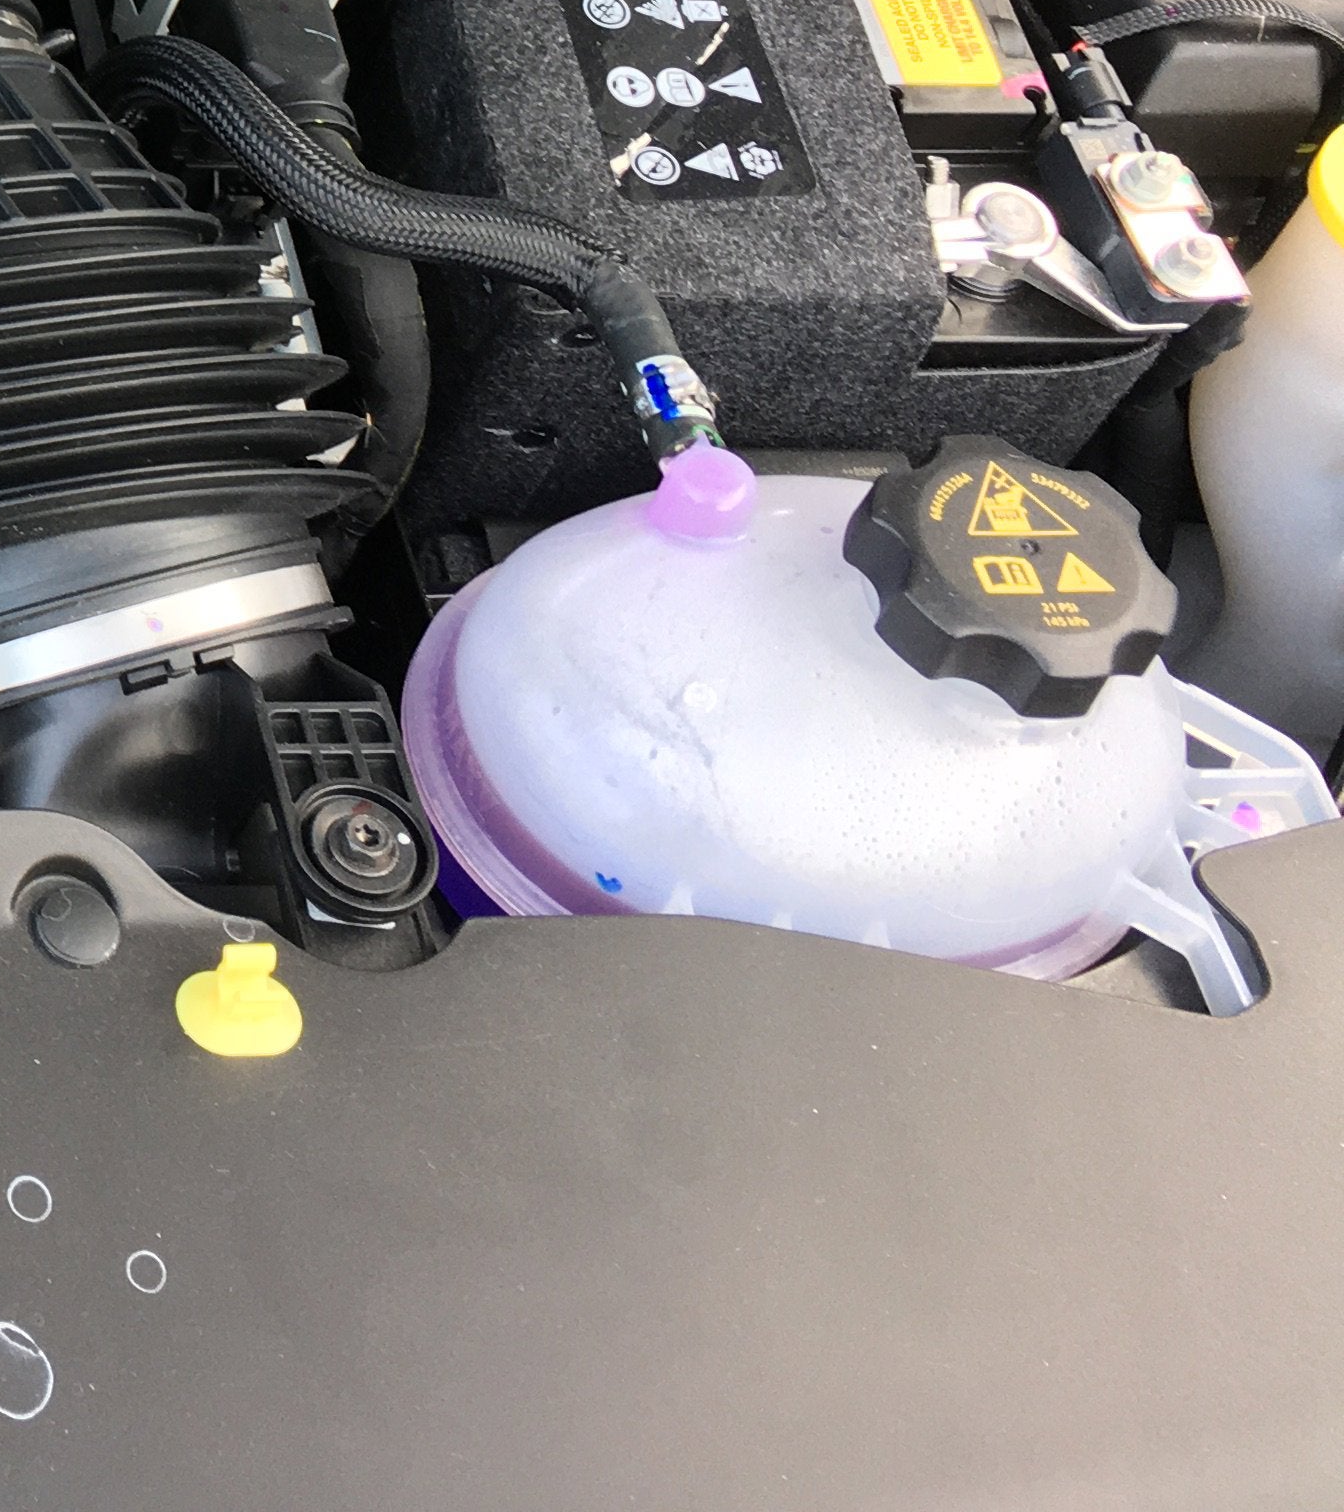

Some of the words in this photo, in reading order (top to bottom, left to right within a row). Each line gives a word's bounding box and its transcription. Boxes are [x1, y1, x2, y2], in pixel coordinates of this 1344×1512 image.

[901, 0, 921, 21] NOT
[894, 19, 923, 62] SEALED
[912, 23, 929, 40] DO
